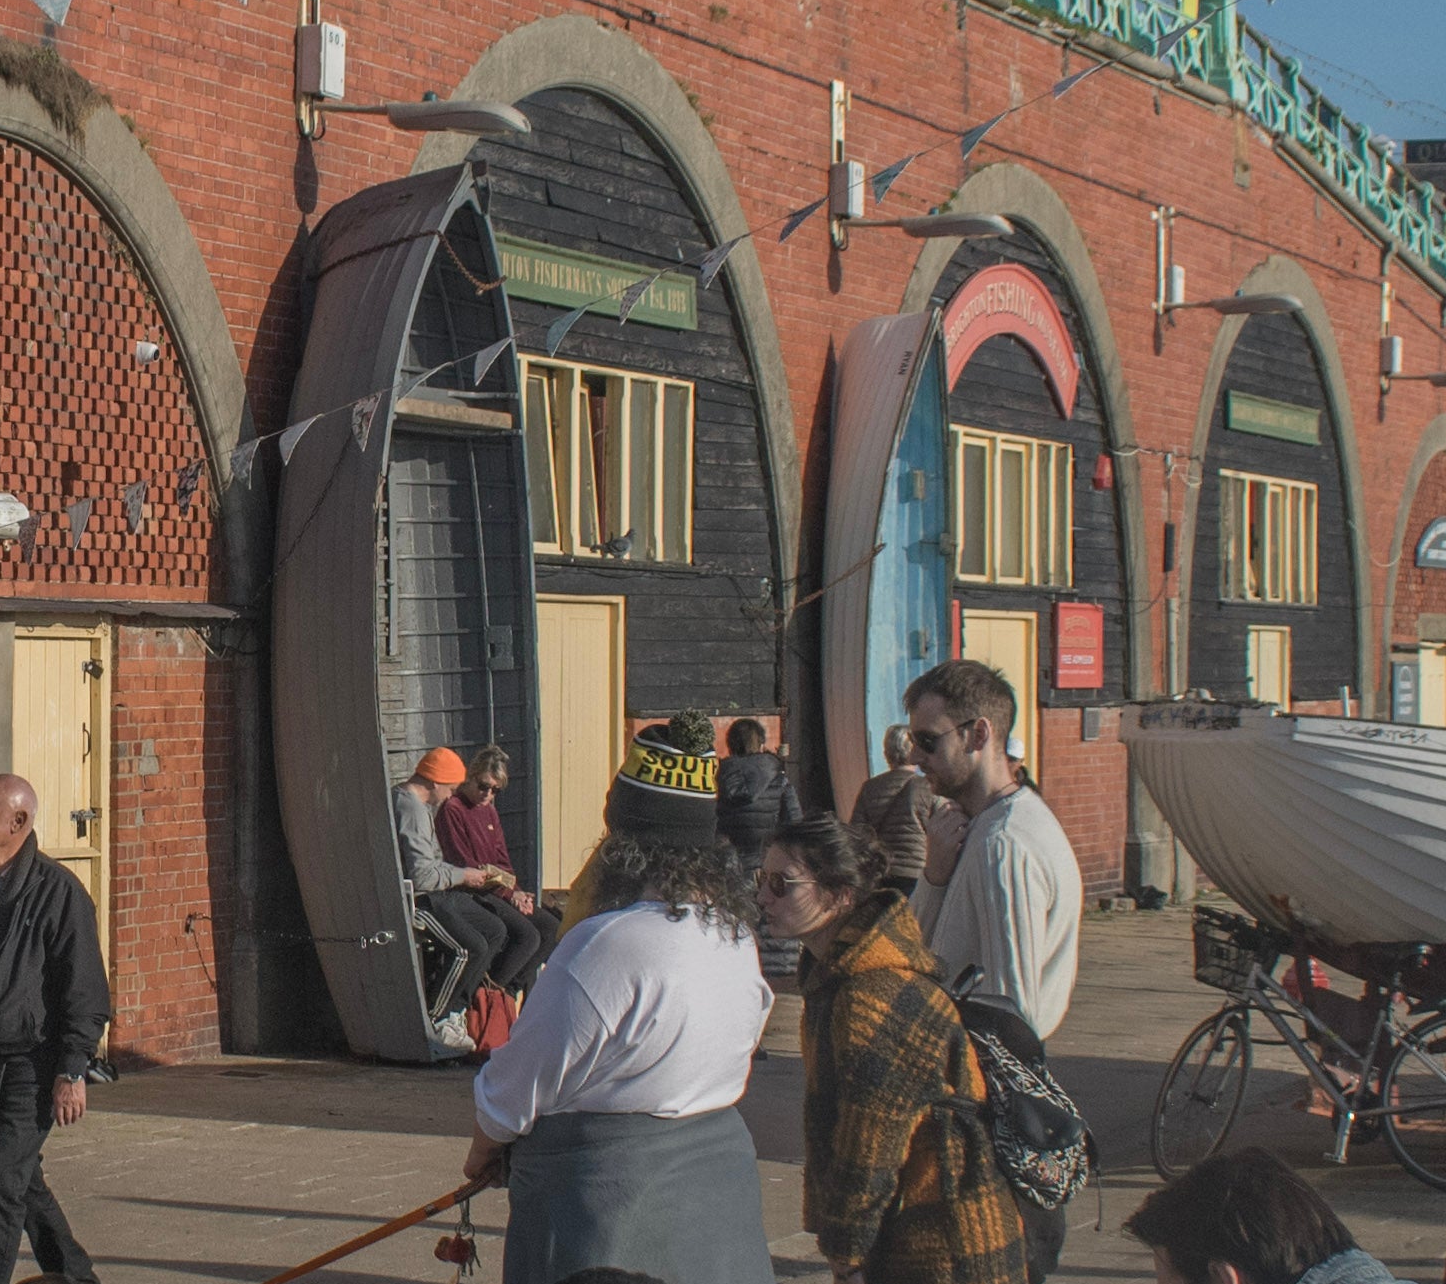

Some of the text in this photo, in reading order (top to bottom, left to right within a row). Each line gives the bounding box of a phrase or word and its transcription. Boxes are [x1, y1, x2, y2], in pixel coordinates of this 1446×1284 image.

[985, 281, 1036, 328] FISHING
[897, 349, 916, 376] RYAN
[634, 764, 714, 791] PHILL
